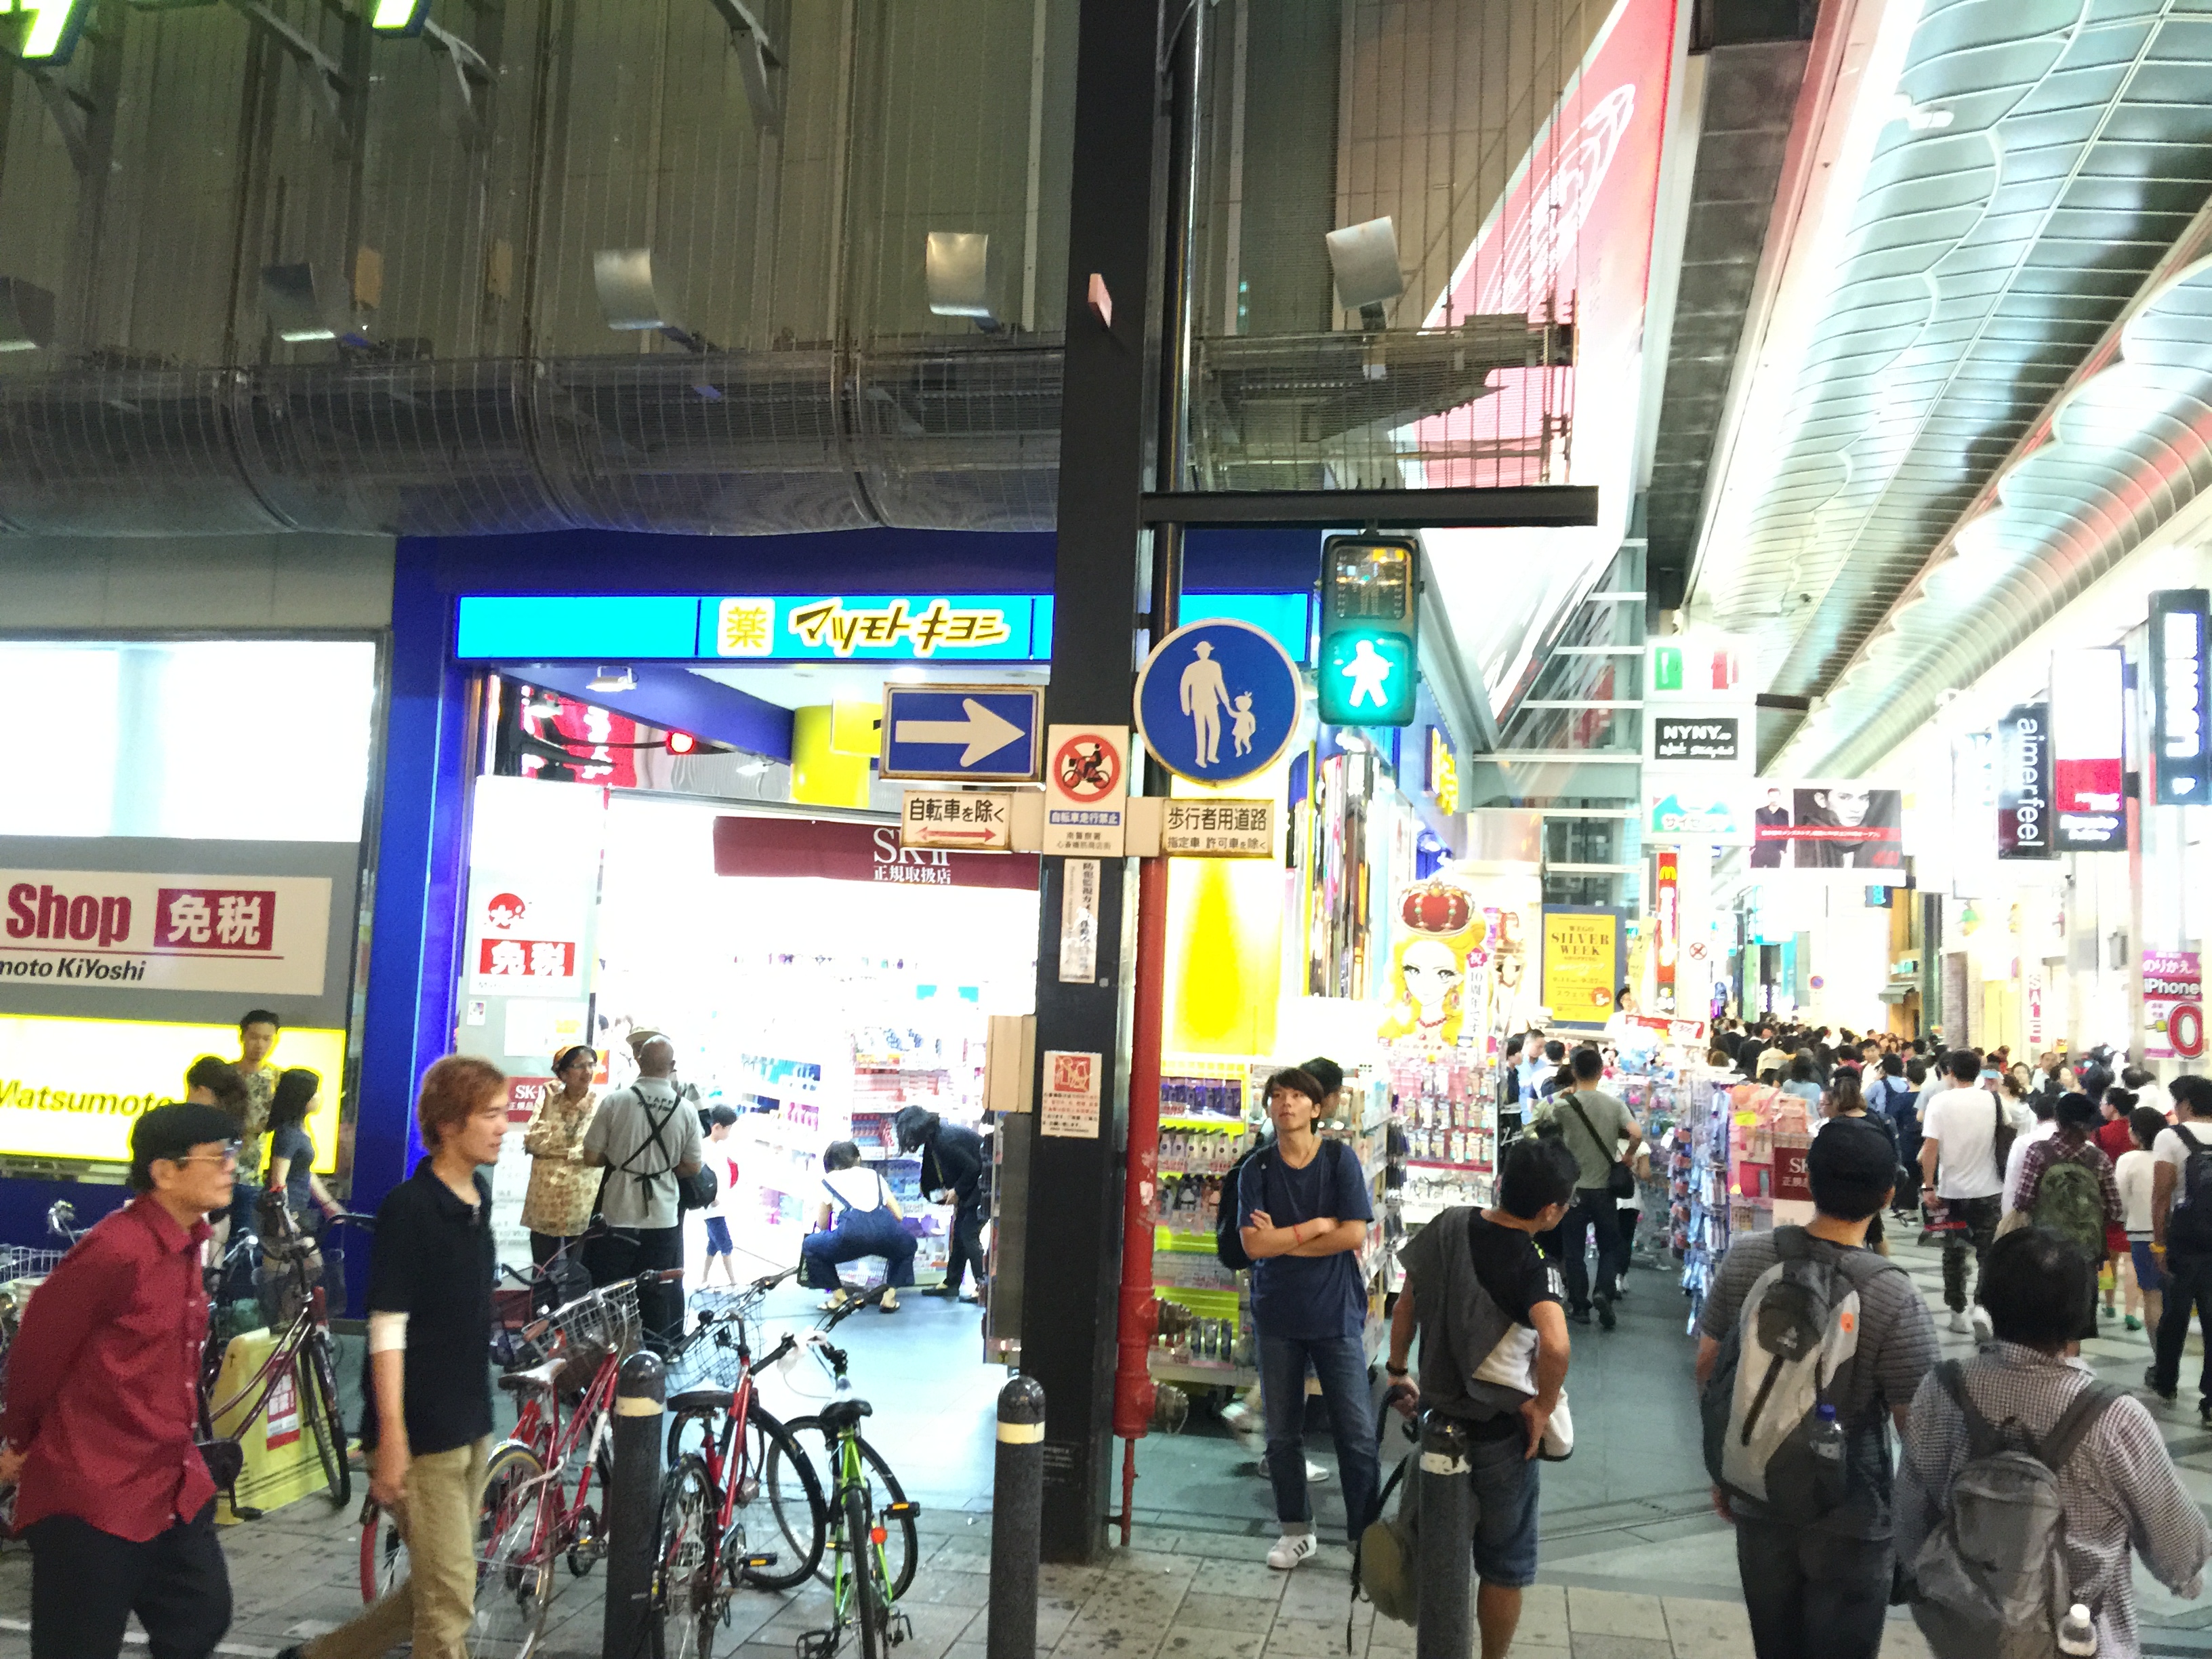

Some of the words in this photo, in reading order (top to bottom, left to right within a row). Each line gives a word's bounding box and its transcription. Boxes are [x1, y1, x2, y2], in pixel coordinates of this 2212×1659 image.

[726, 605, 767, 649] 薬
[794, 603, 1004, 651] マツモトキヨシ
[2017, 717, 2045, 847] aimerfeel
[909, 797, 1005, 823] 自転車を除く
[1168, 806, 1267, 831] 歩行者用道路
[874, 865, 951, 884] 正規取扱店
[6, 883, 132, 947] Shop
[167, 894, 262, 945] 免税
[1551, 933, 1610, 945] SILVER
[1560, 945, 1600, 956] WEEK
[56, 958, 146, 981] KiYoshi
[491, 941, 565, 977] 免税
[2144, 978, 2201, 996] iPhone
